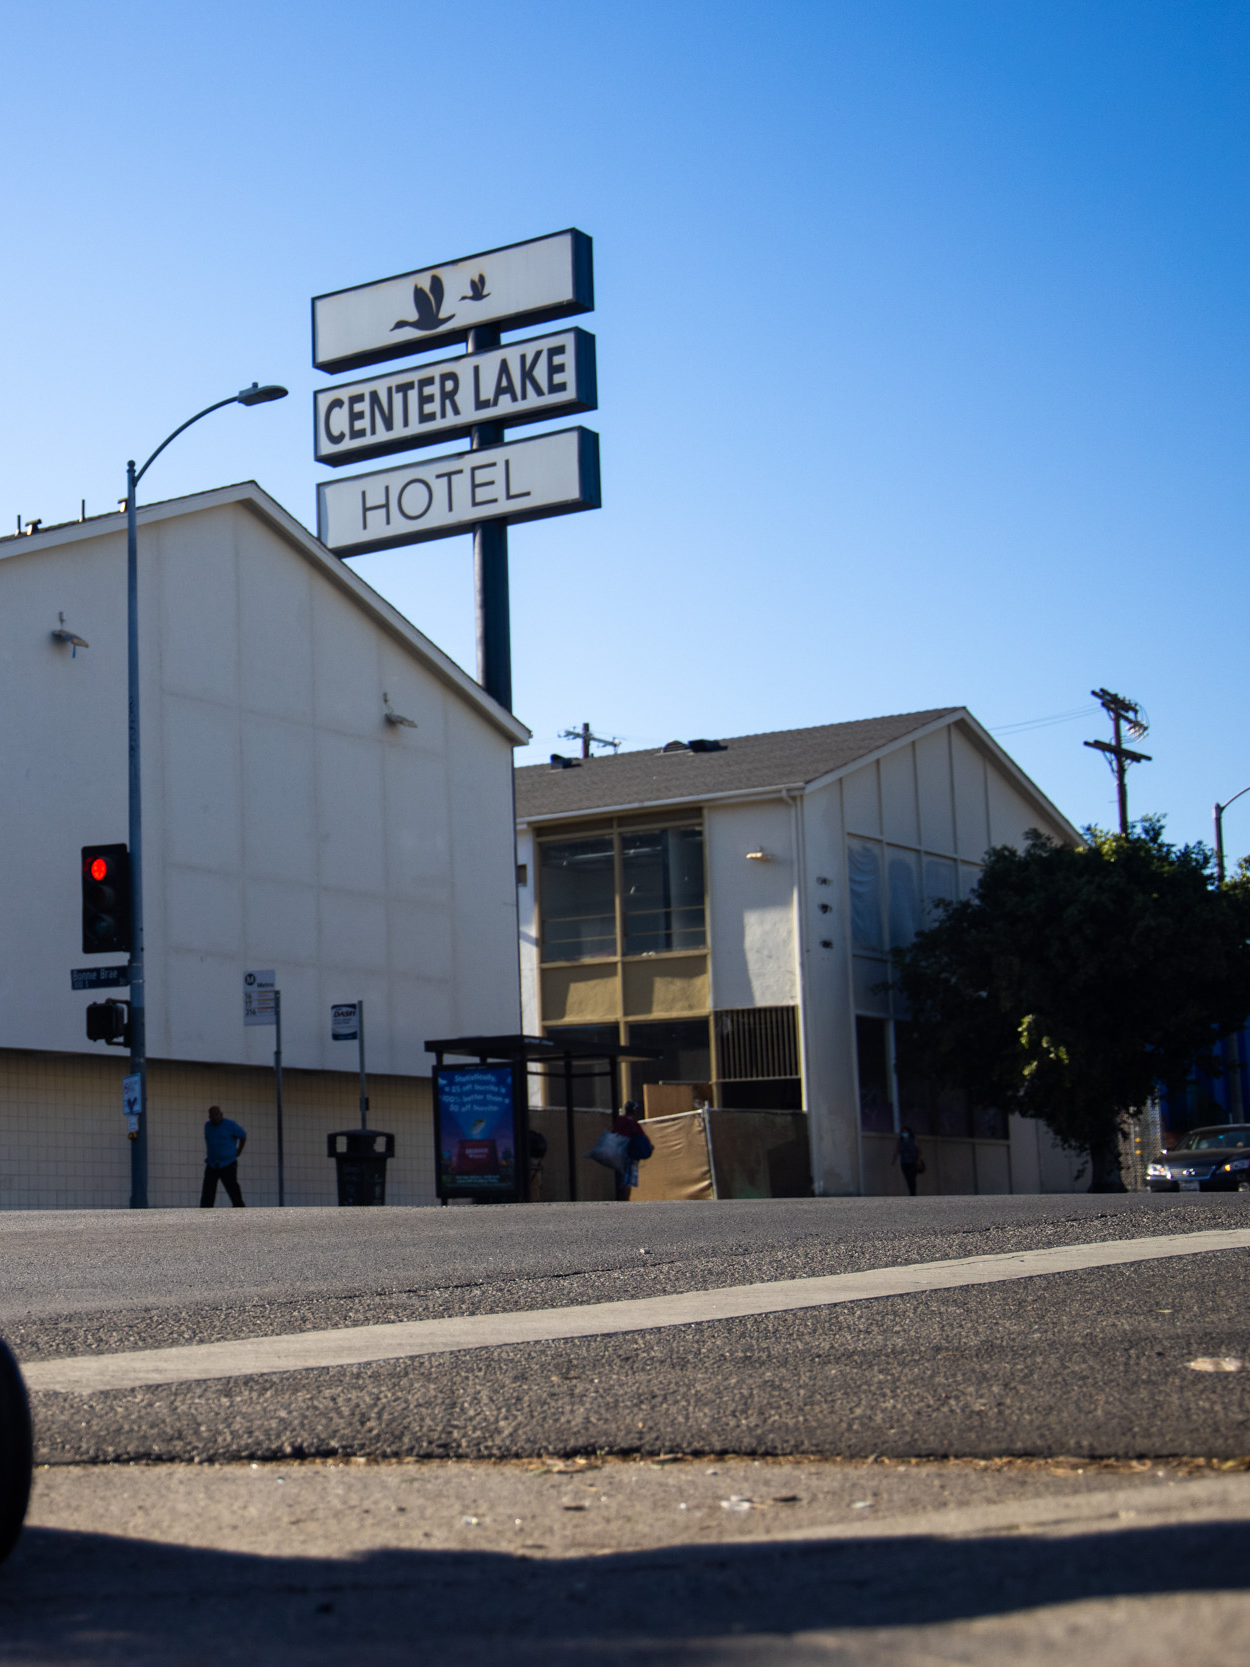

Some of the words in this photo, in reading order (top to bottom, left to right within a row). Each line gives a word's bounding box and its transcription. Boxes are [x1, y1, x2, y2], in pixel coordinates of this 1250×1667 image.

[323, 371, 461, 445] CENTER
[473, 344, 568, 412] LAKE
[361, 458, 531, 531] HOTEL
[73, 970, 97, 982] Bonnie
[100, 968, 118, 979] Brae
[334, 1010, 356, 1018] DASH
